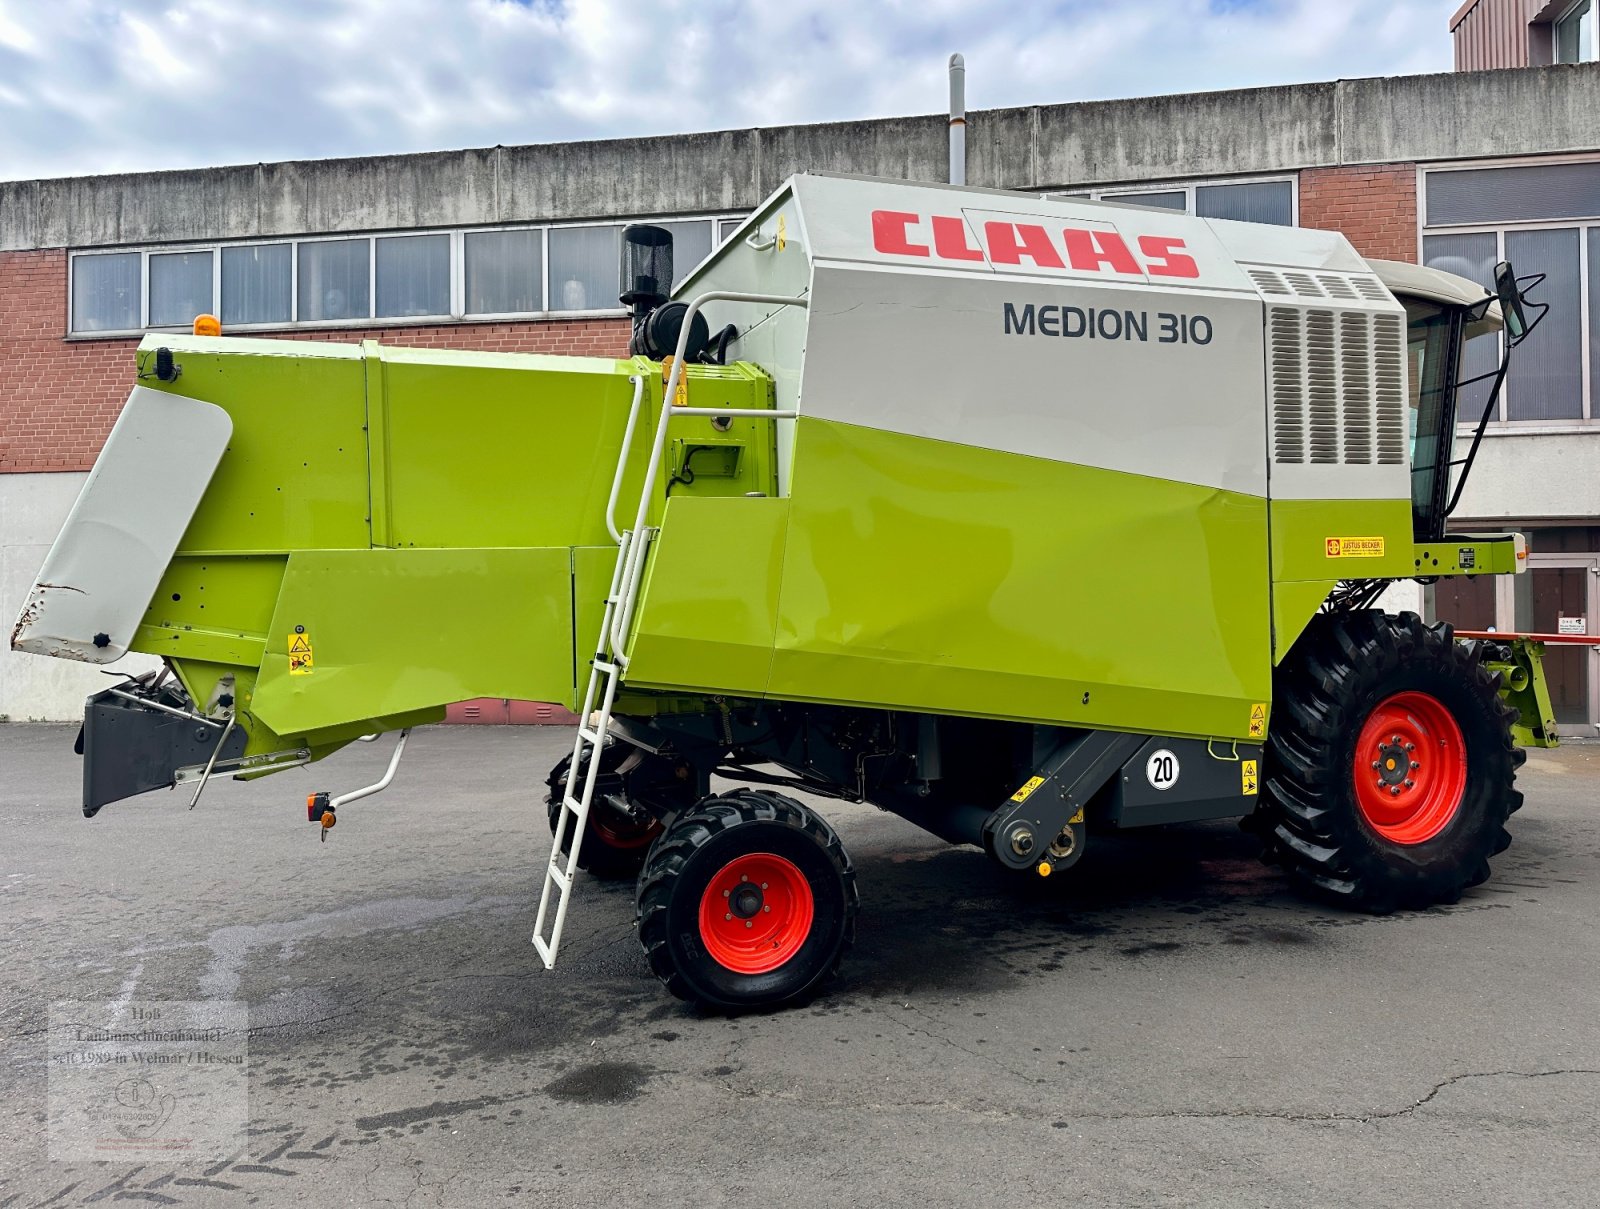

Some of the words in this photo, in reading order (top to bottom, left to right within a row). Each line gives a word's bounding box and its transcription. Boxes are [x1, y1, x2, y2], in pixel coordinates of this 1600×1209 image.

[871, 210, 1199, 279] CLAAS
[1003, 302, 1148, 342] MEDION
[1158, 312, 1213, 345] 310
[1342, 541, 1360, 549] JUSTUS
[1362, 541, 1380, 549] BECKER
[1153, 757, 1173, 783] 20
